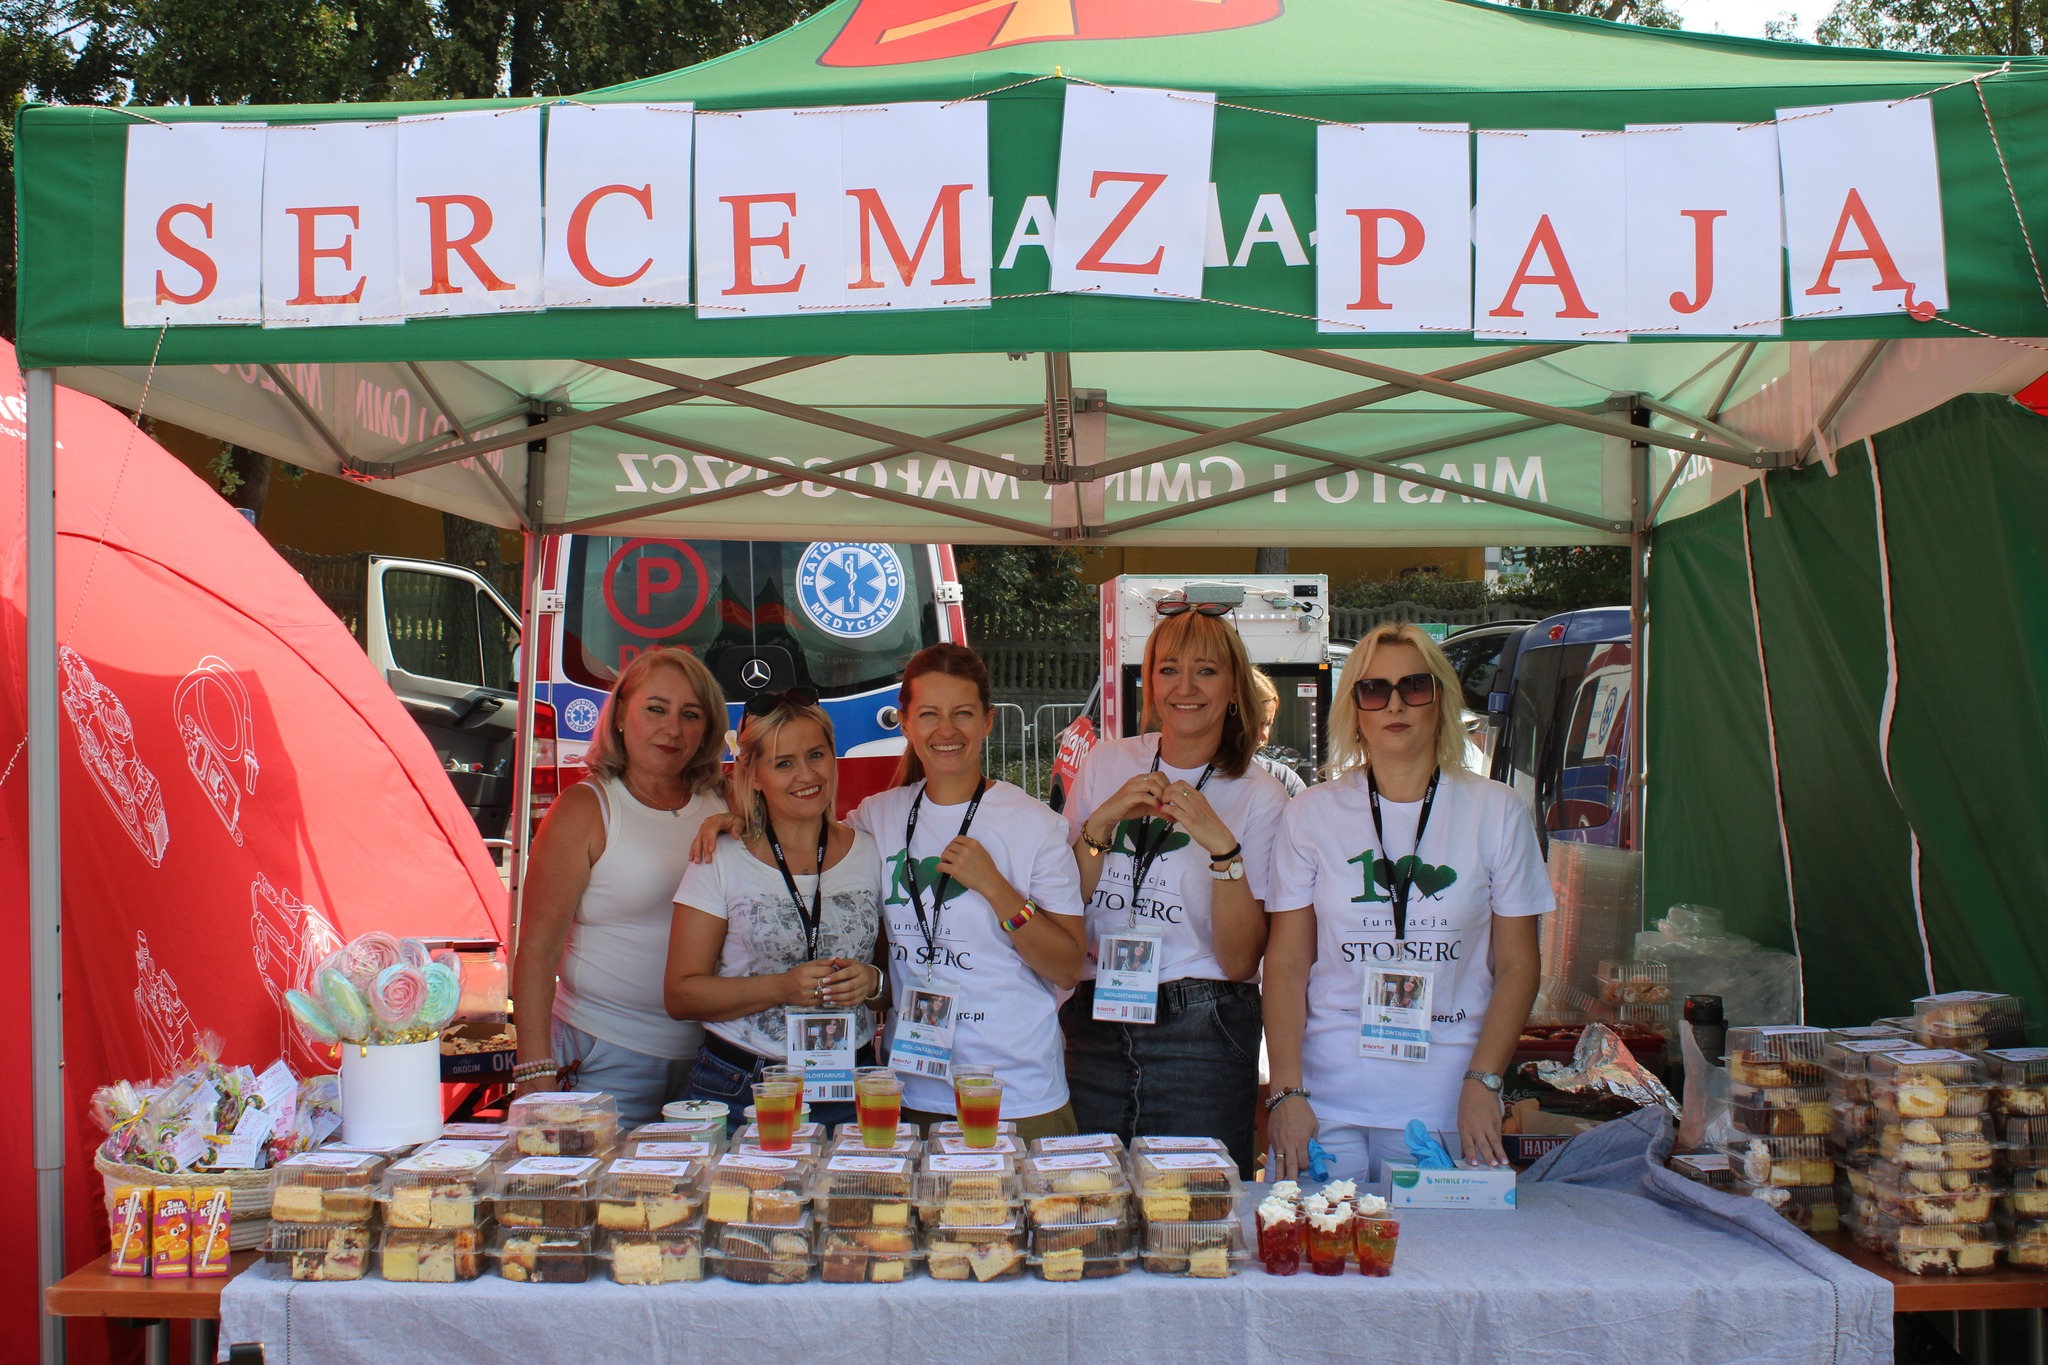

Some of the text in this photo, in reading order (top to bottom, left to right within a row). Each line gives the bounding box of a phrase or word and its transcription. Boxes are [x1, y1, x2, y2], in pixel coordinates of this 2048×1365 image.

[156, 183, 976, 306] SERCEM
[1076, 170, 1168, 275] Z
[811, 598, 894, 631] MEDYCZNE
[1108, 868, 1166, 887] funcja
[1088, 890, 1125, 910] TO
[1363, 917, 1448, 928] funacja
[1341, 942, 1394, 962] STO
[453, 1064, 481, 1074] OKOCIM
